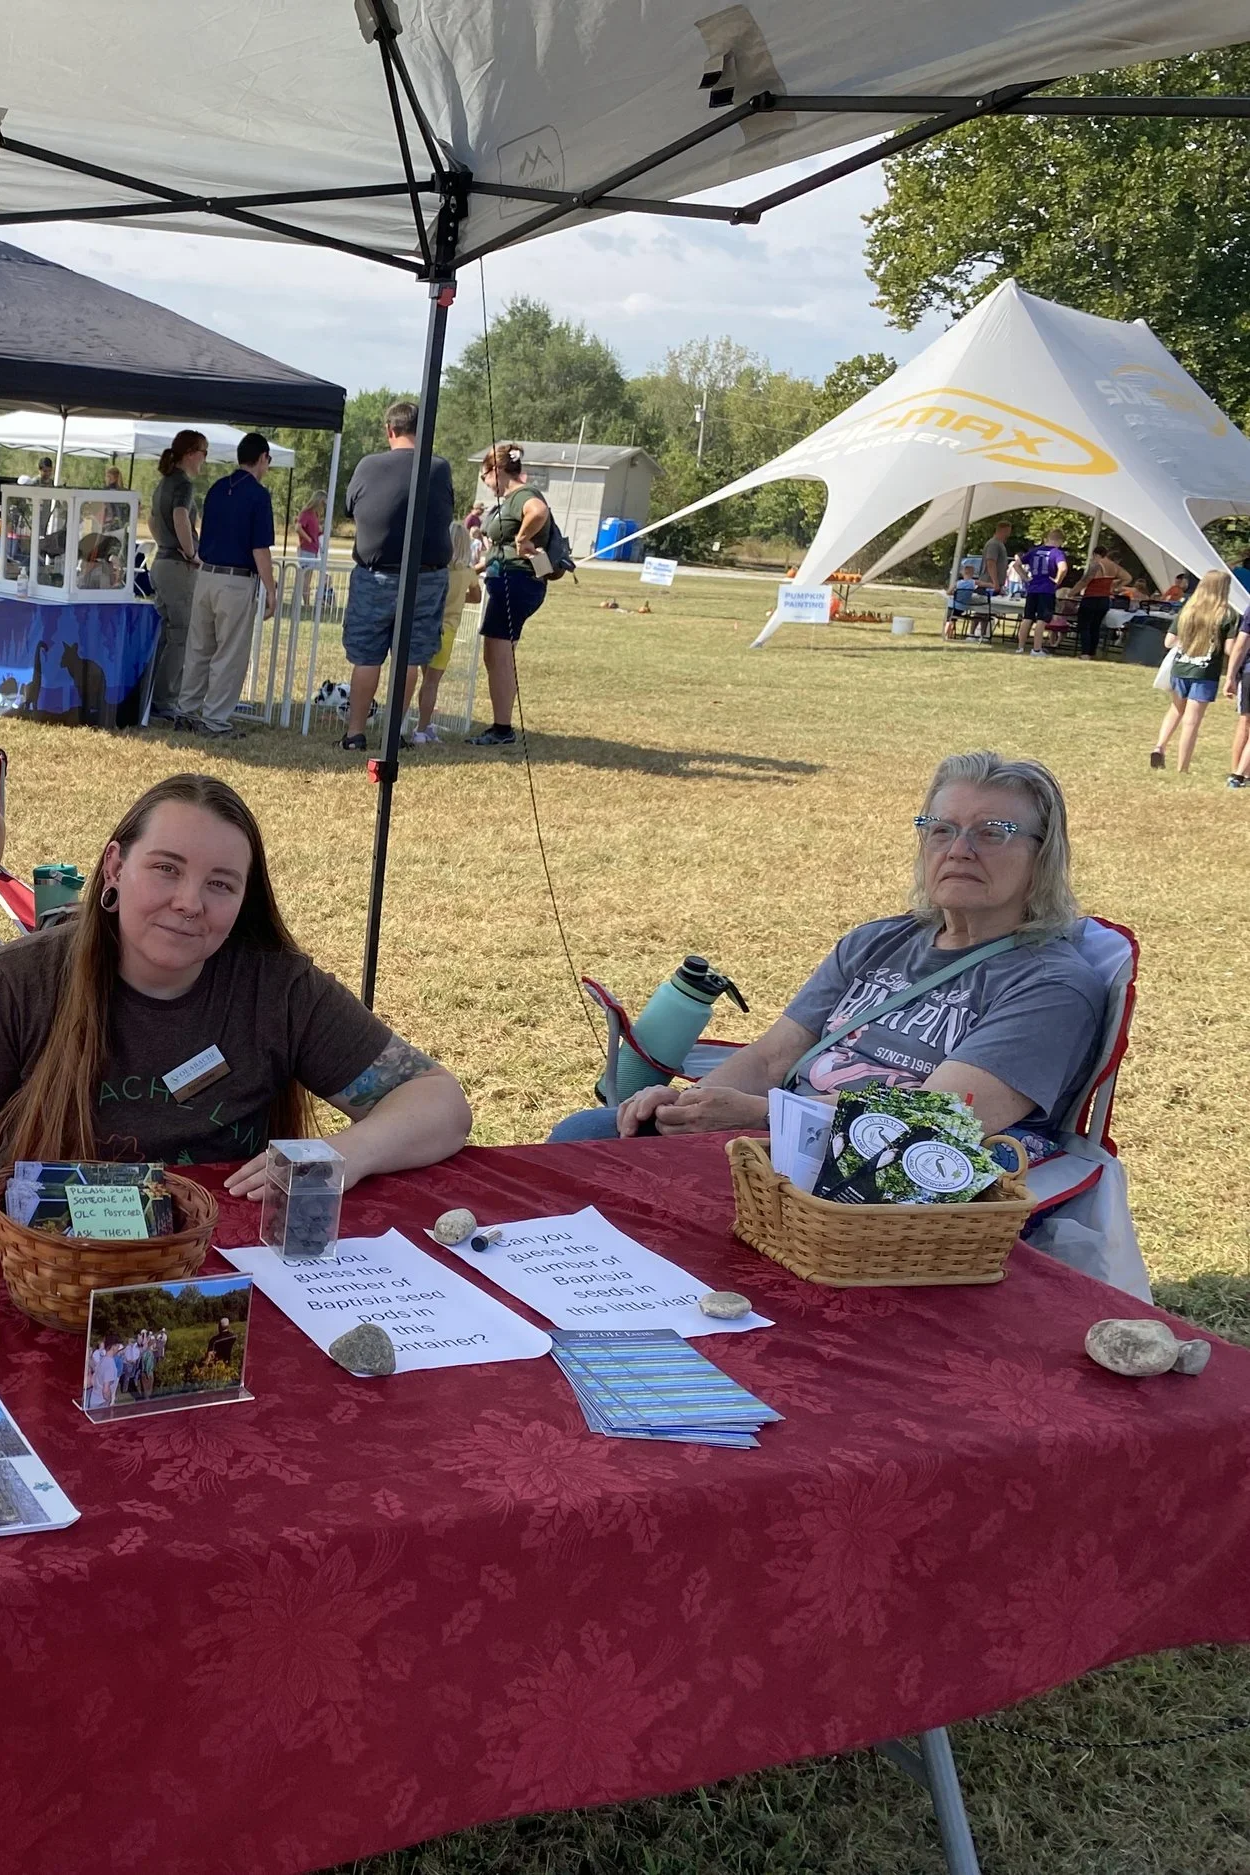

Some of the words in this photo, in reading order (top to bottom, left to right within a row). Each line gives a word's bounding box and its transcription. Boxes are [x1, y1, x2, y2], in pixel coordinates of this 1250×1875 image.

[1033, 554, 1050, 575] 11
[784, 592, 825, 600] PUMPKIN
[784, 601, 825, 609] PAINTING
[874, 1046, 911, 1067] SINCE
[912, 1171, 956, 1190] CONSERVANCY
[73, 1195, 116, 1205] SOMEONE
[122, 1195, 136, 1203] AN
[74, 1209, 96, 1219] OLC
[76, 1229, 94, 1238] ASK
[100, 1228, 132, 1238] THEM
[494, 1234, 535, 1248] Can
[536, 1231, 573, 1246] you
[281, 1254, 334, 1268] Can
[333, 1252, 368, 1266] you
[506, 1247, 564, 1263] guess
[565, 1243, 599, 1255] the
[523, 1259, 602, 1275] number
[603, 1253, 623, 1267] of
[294, 1268, 356, 1284] guess
[357, 1264, 392, 1276] the
[552, 1270, 634, 1287] Baptisia
[306, 1279, 387, 1295] number
[393, 1276, 412, 1288] of
[573, 1285, 634, 1299] seeds
[635, 1282, 657, 1295] in
[307, 1294, 392, 1312] Baptisia
[399, 1288, 446, 1303] seed
[566, 1301, 608, 1317] this
[608, 1298, 656, 1313] little
[656, 1293, 699, 1309] vial?
[356, 1308, 411, 1325] pods
[415, 1305, 436, 1318] in
[391, 1321, 436, 1336] this
[599, 1331, 623, 1339] OLC
[624, 1330, 655, 1339] Events
[391, 1332, 490, 1352] ontainer?
